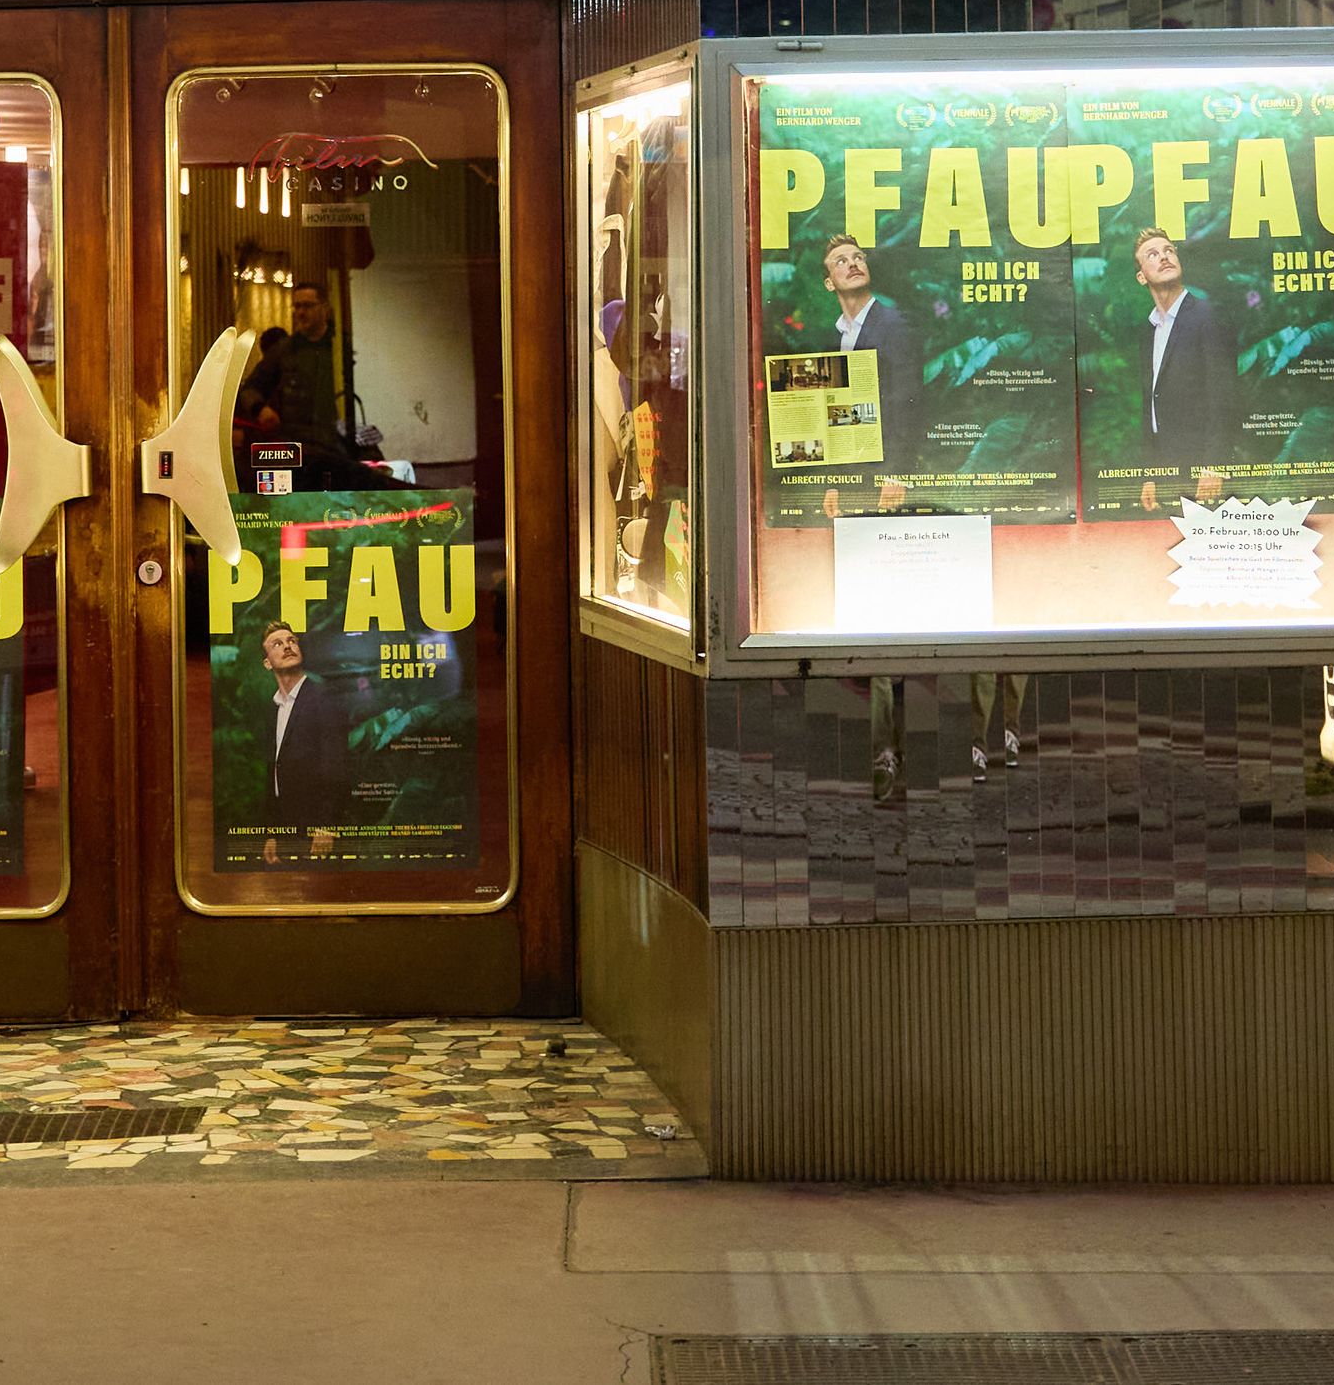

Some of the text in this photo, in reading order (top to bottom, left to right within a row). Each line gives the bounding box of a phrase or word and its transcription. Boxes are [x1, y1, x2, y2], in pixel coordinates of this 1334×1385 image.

[1083, 101, 1140, 112] EIN FILM VON
[1258, 98, 1296, 109] VIENNALE
[776, 107, 833, 117] EIN FILM VON
[951, 108, 990, 118] VIENNALE
[1083, 110, 1168, 121] BERNHARD WENGER
[776, 117, 862, 126] BERNHARD WENGER
[286, 174, 408, 192] CASINO
[759, 147, 1071, 249] PFAU
[1272, 252, 1308, 271] BIN
[962, 261, 1040, 281] BIN ICH
[962, 284, 1028, 303] ECHT?
[258, 450, 294, 460] ZIEHEN
[1253, 463, 1272, 471] ANTON
[936, 473, 956, 481] ANTON
[1098, 467, 1180, 479] ALBRECHT SCHUCH
[781, 474, 863, 485] ALBRECHT SCHUCH
[235, 512, 269, 521] FILM VON
[370, 512, 403, 521] VIENNALE
[1221, 510, 1275, 521] Premiere
[236, 520, 294, 529] NHARD WENGER
[932, 532, 950, 540] Echt
[1192, 527, 1207, 536] 20.
[1253, 527, 1280, 536] 18:00
[1282, 527, 1300, 537] Uhr
[1238, 543, 1263, 551] 20:15
[1265, 542, 1283, 551] Uhr
[208, 544, 476, 634] PFAU
[380, 643, 447, 661] BIN ICH
[380, 663, 437, 680] ECHT?
[227, 827, 266, 835] ALBRECHT
[267, 826, 297, 835] SCHUCH
